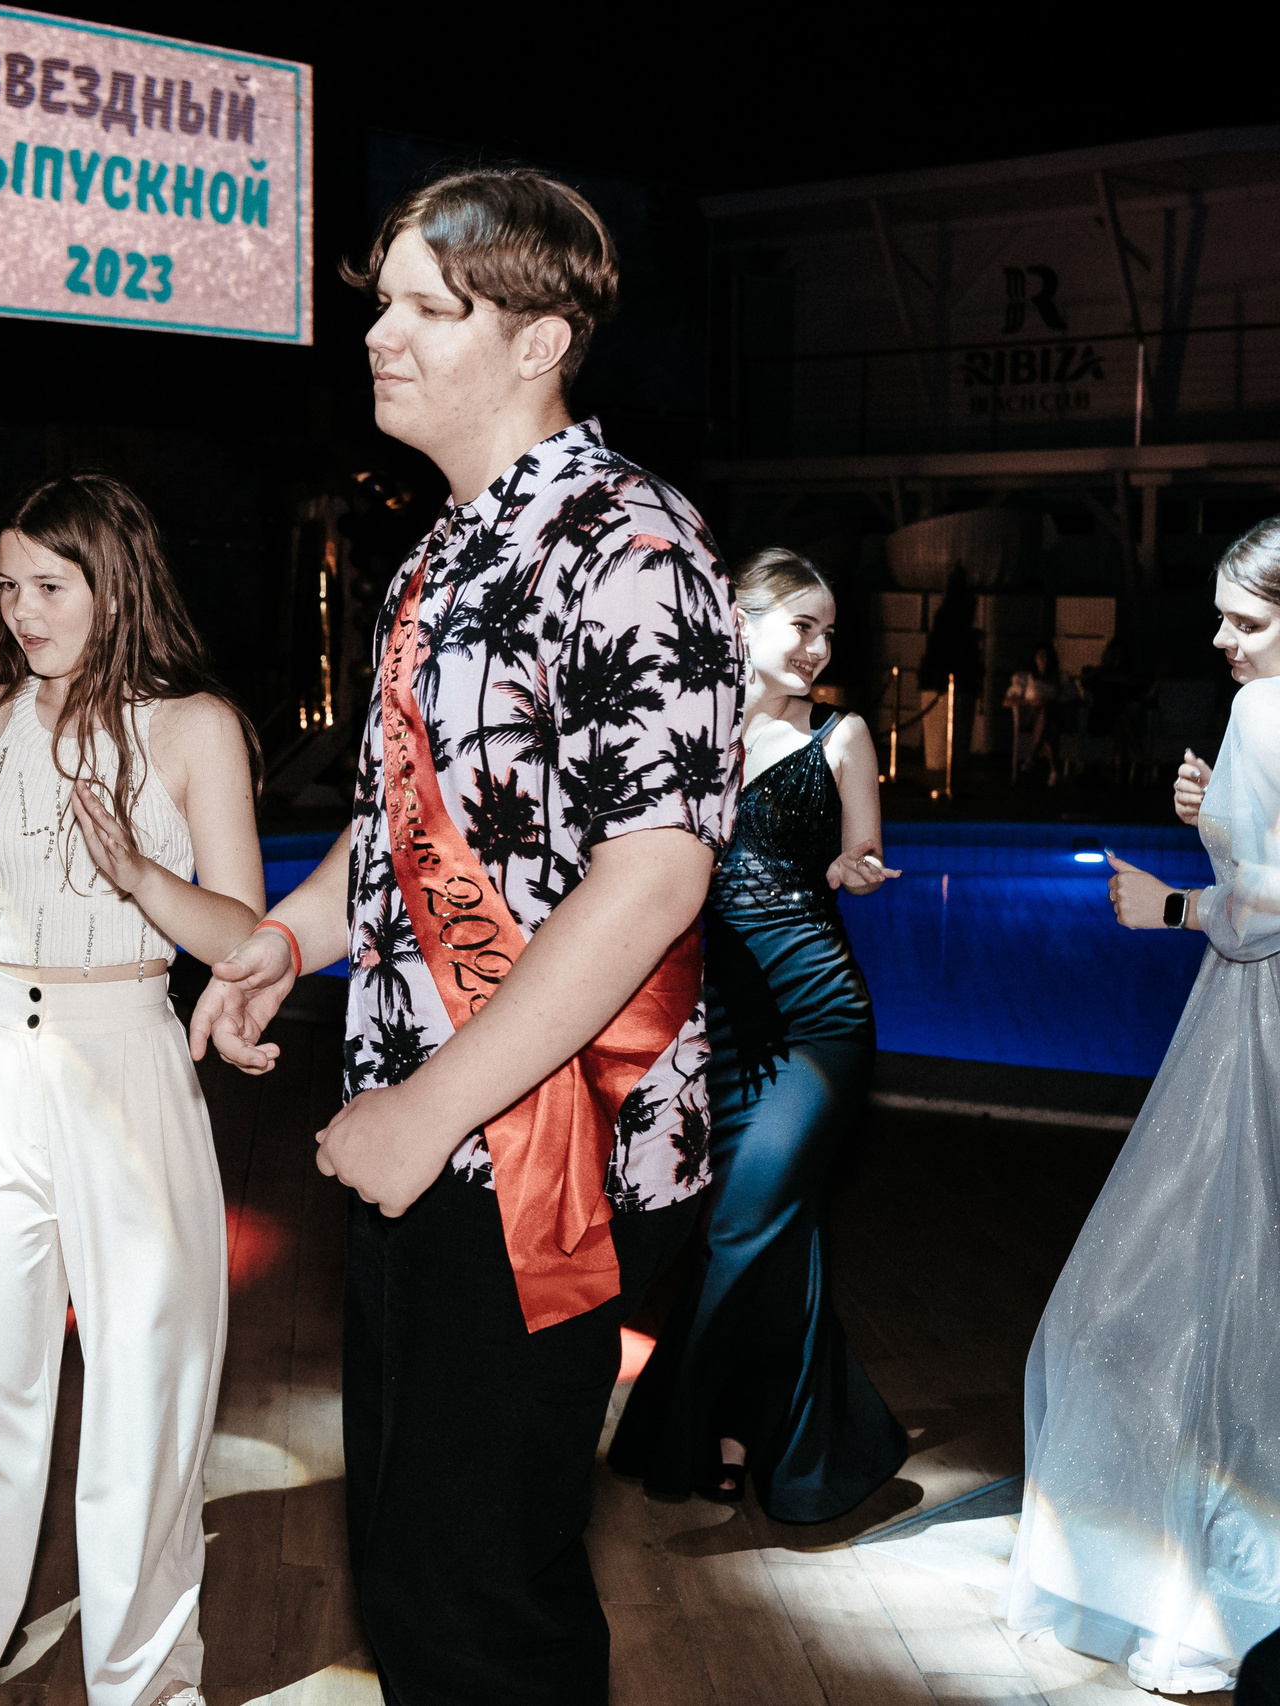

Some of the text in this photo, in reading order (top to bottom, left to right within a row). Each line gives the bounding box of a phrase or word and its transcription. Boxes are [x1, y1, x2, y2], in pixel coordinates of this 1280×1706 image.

[66, 245, 173, 303] 2023
[1001, 264, 1067, 334] R
[959, 345, 1107, 386] RIBIZA
